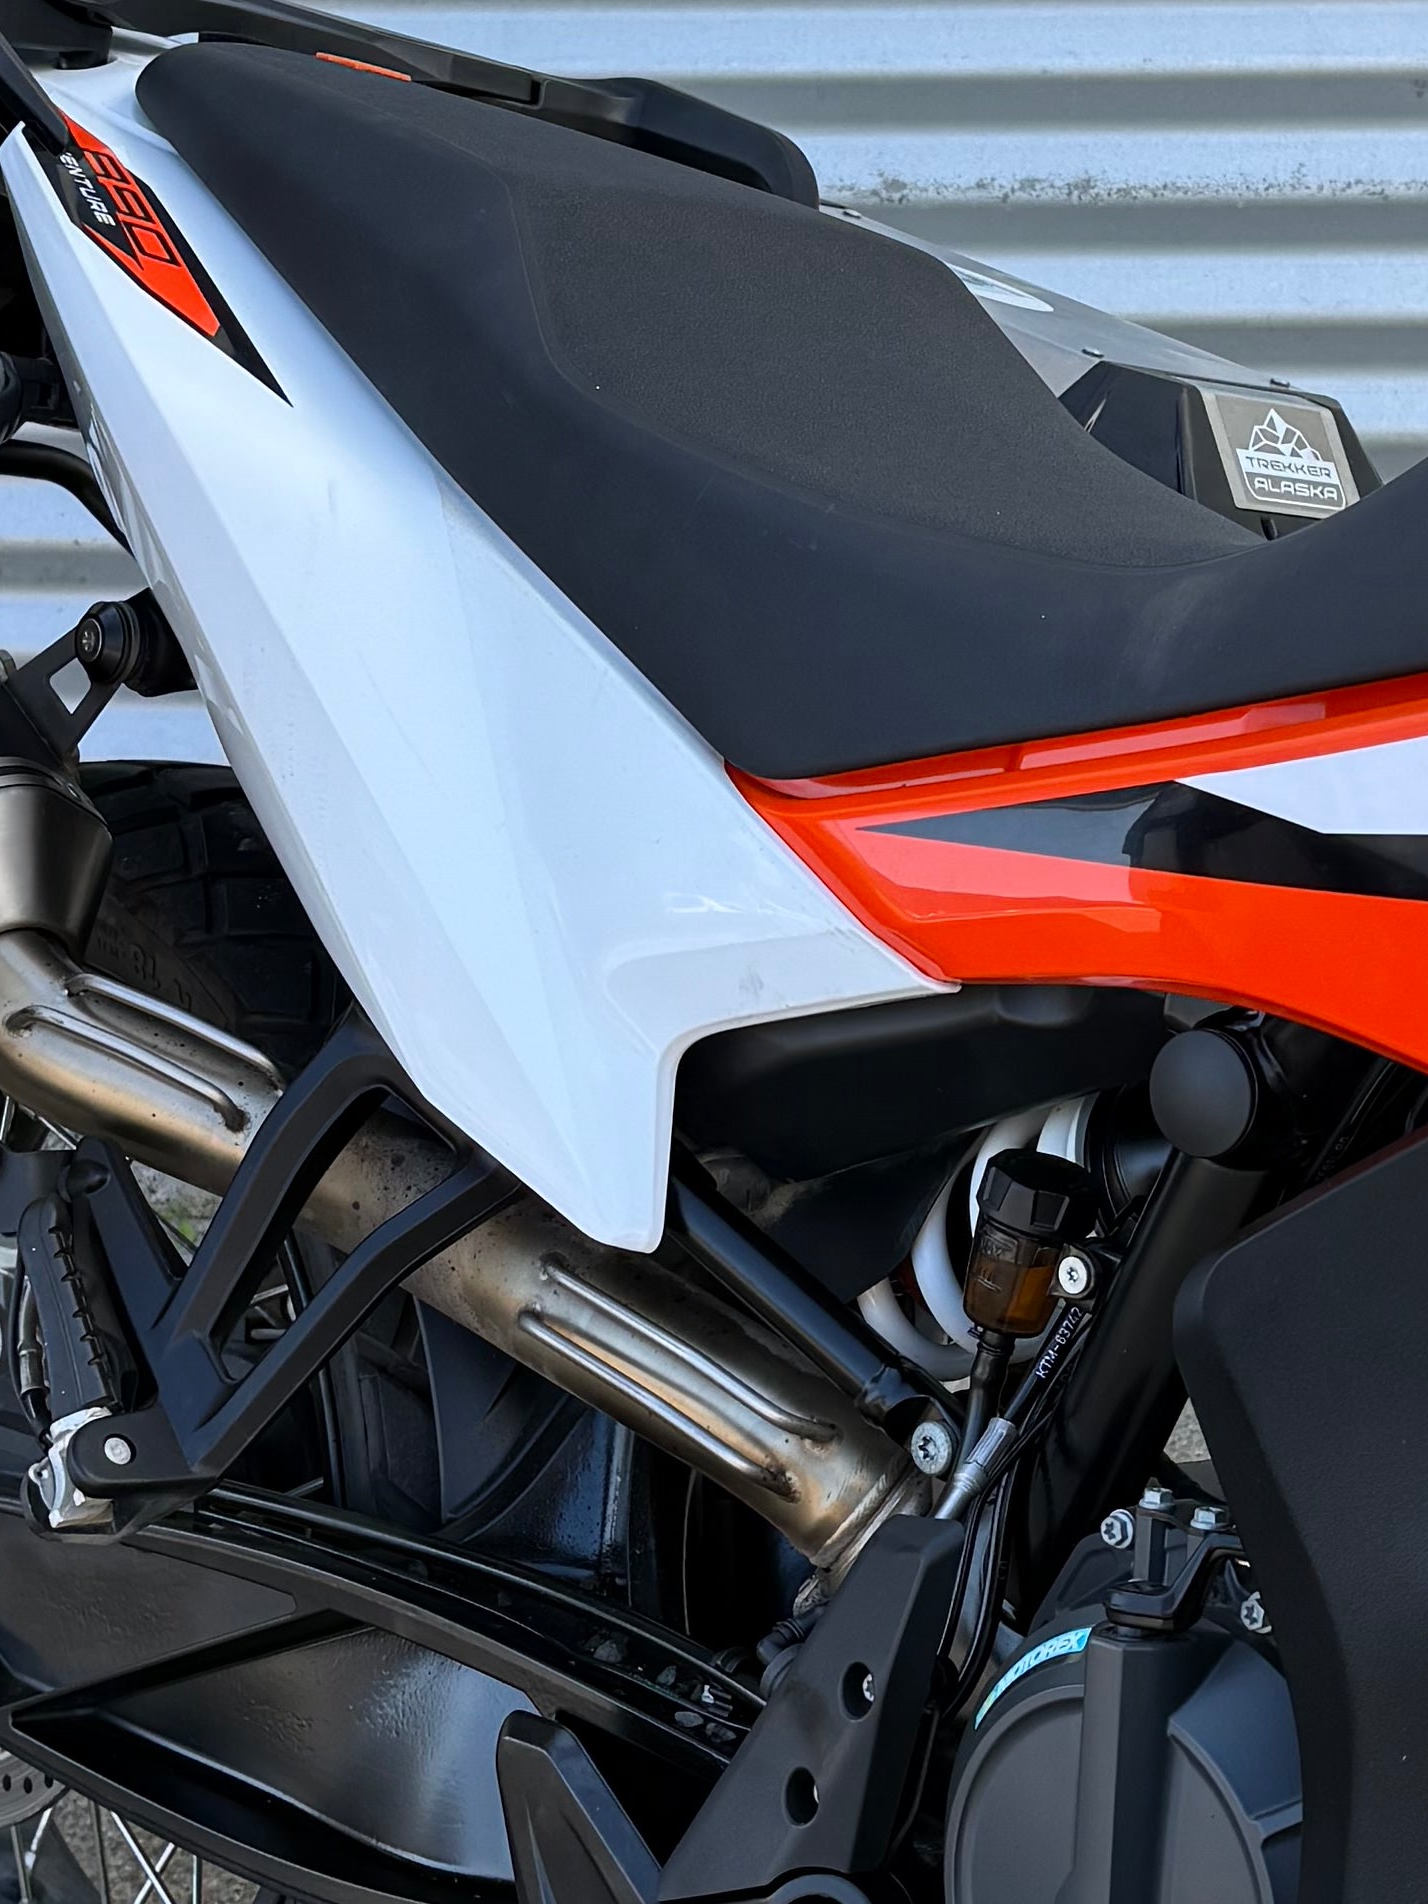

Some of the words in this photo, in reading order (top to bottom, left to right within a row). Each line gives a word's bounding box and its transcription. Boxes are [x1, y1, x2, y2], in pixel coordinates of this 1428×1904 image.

[58, 152, 117, 227] ENTURE
[1244, 455, 1332, 479] TREKKER
[1253, 476, 1338, 501] ALASKA
